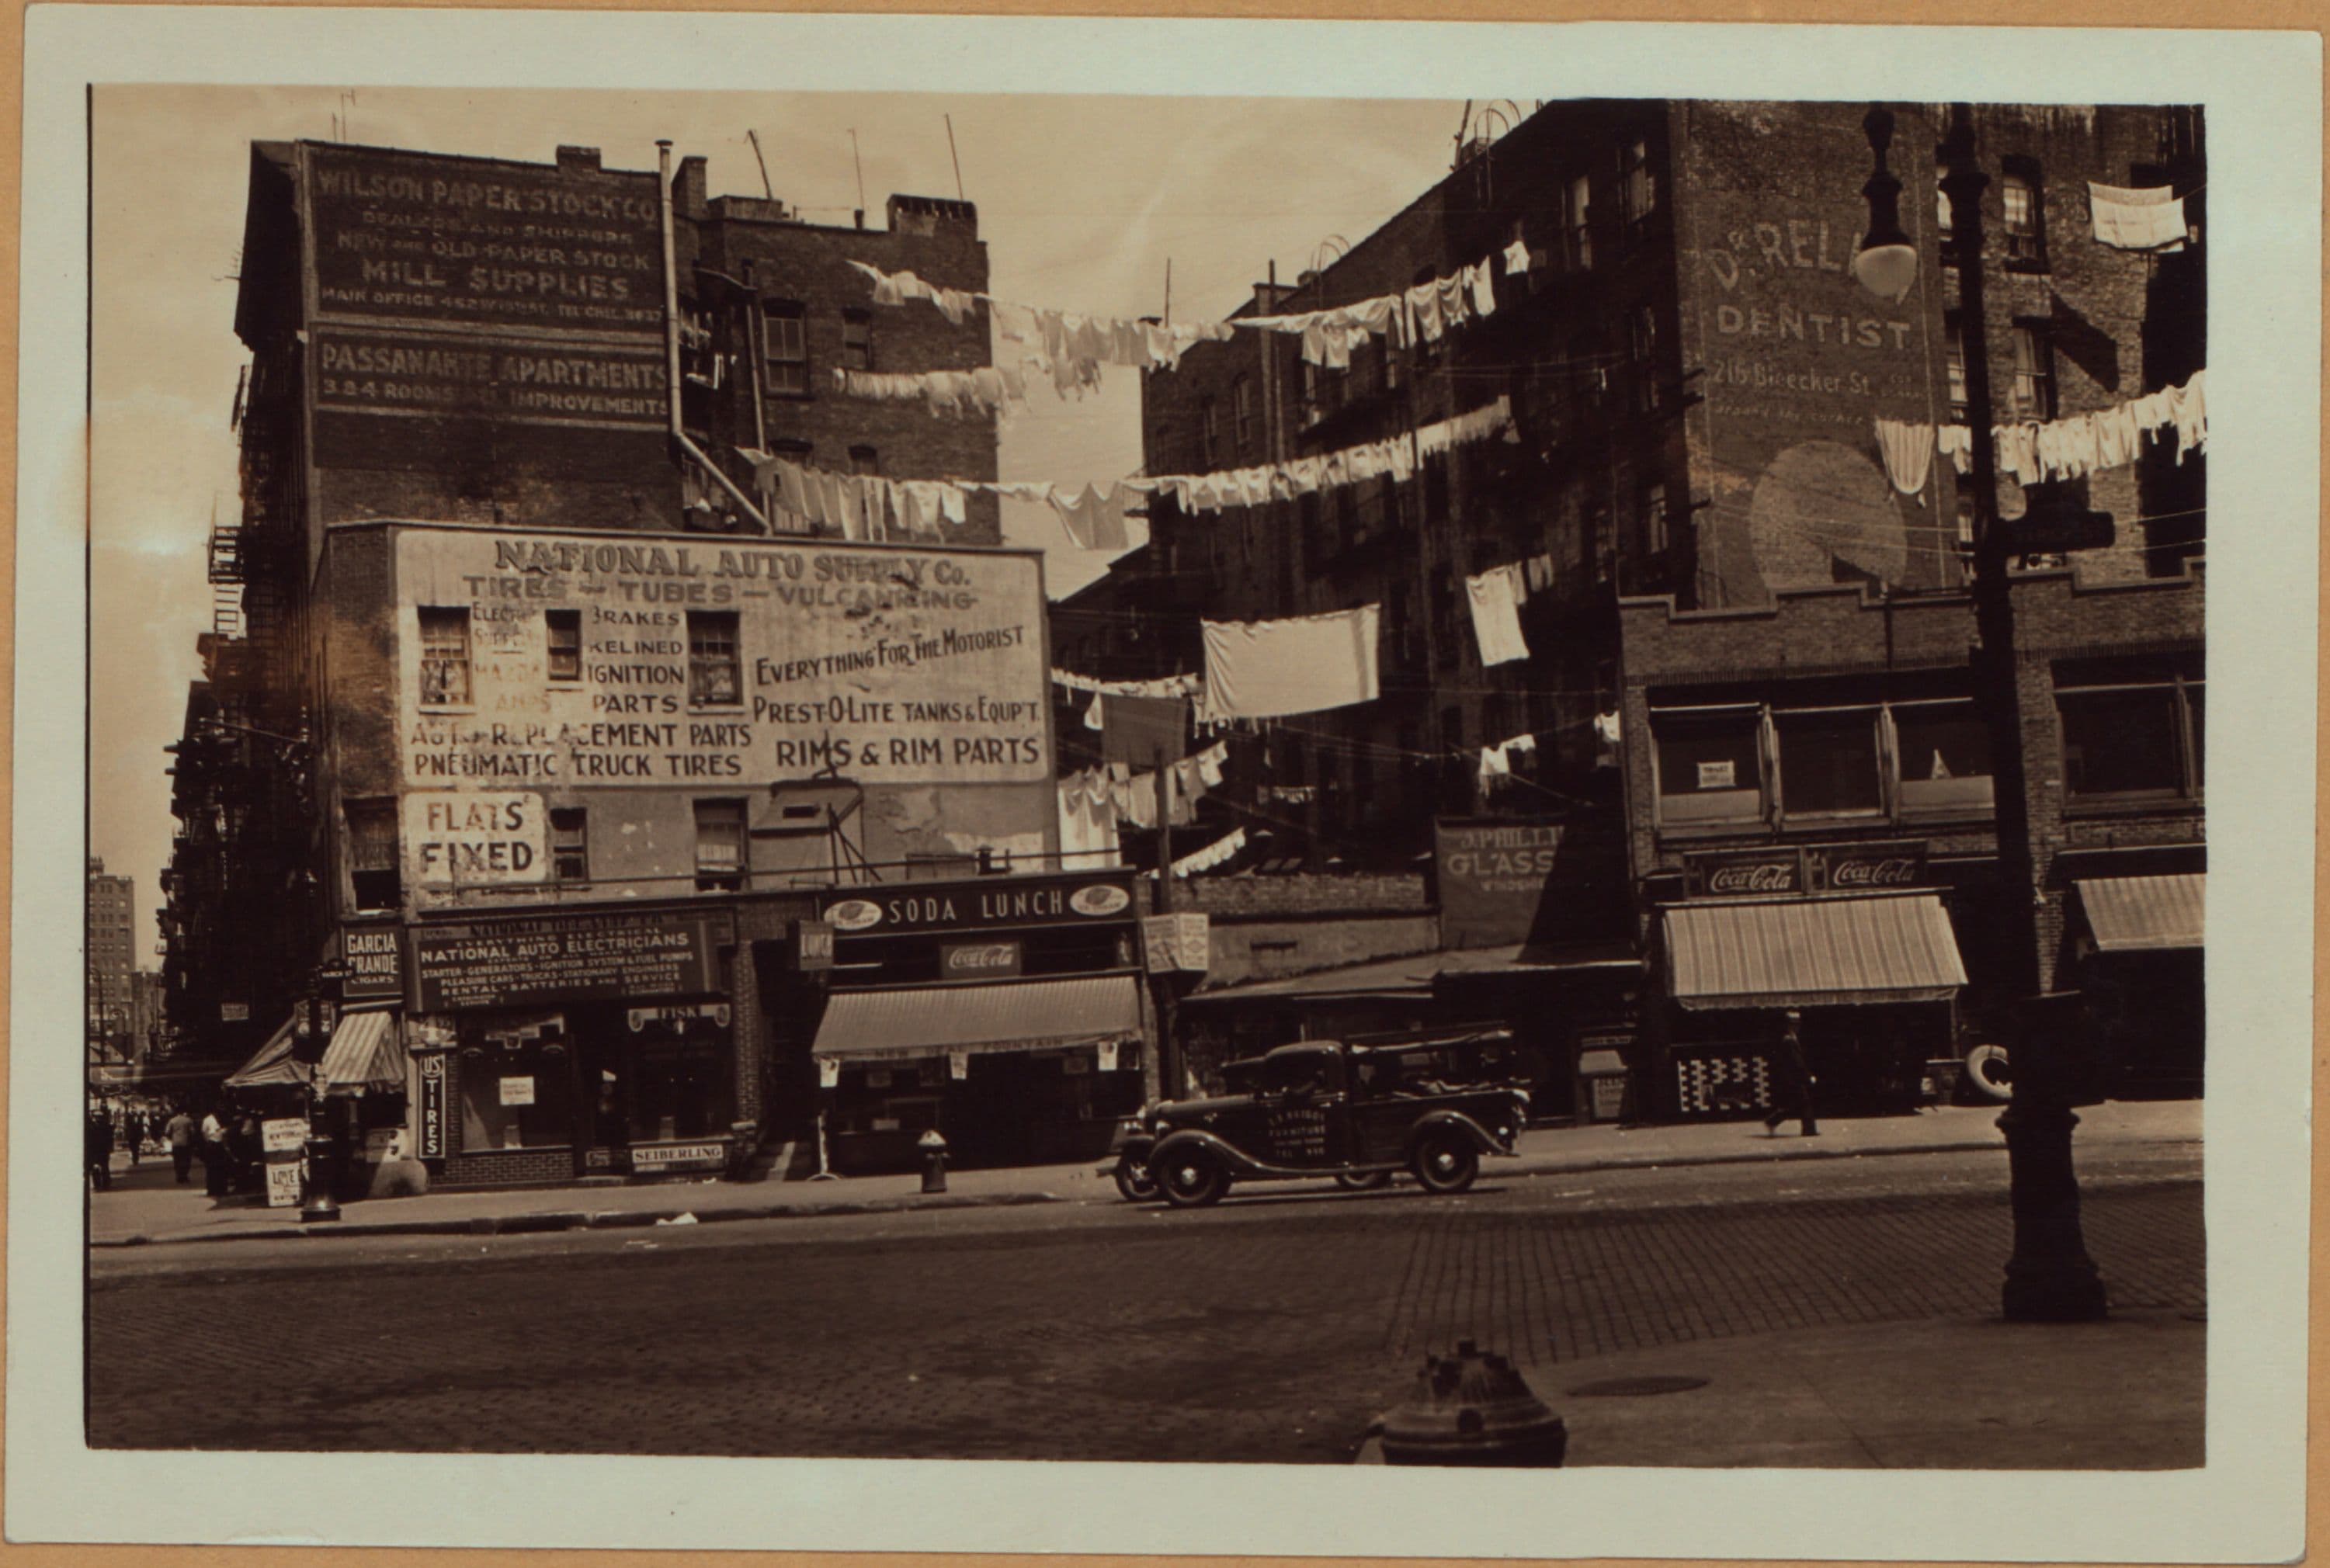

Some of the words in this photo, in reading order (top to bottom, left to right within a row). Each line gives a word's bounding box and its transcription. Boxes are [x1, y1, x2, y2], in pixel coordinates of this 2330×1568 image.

[317, 168, 425, 201] WILSON
[431, 179, 522, 212] PAPER
[528, 188, 621, 220] STOCK
[431, 240, 477, 258] OLD
[486, 244, 567, 266] PAPER
[573, 249, 650, 272] STOCK
[362, 256, 446, 288] MILL
[468, 265, 630, 302] SUPPLIES
[321, 286, 367, 306] MAIN
[372, 291, 436, 308] OFFICE
[1717, 303, 1911, 350] DENTIST
[321, 342, 492, 381] PASSANANTE
[496, 355, 666, 391] APARTMENTS
[509, 389, 667, 416] IMPROVEMENTS
[495, 539, 699, 577] NATIONAL
[713, 550, 804, 580] AUTO
[462, 575, 568, 600] TIRES
[617, 580, 733, 605] TUBES
[942, 625, 1025, 655] MOTORIST
[587, 664, 685, 685] IGNITION
[592, 694, 679, 714] PARTS
[901, 702, 962, 723] TANKS
[964, 705, 977, 722] &
[689, 723, 752, 748] PARTS
[414, 751, 558, 777] PNEUMATIC
[574, 751, 652, 777] TRUCK
[665, 753, 742, 776] TIRES
[776, 738, 852, 768] RIMS
[859, 742, 880, 766] &
[889, 738, 943, 765] RIM
[953, 737, 1040, 765] PARTS
[426, 800, 524, 832] FLATS
[420, 841, 533, 873] FIXED
[1446, 850, 1555, 876] GLASS
[888, 898, 957, 924] SODA
[981, 890, 1063, 919] LUNCH
[346, 931, 398, 955] GARCIA
[420, 945, 510, 963] NATIONAL
[516, 942, 560, 956] AUTO
[566, 931, 690, 953] ELECTRICIANS
[422, 966, 463, 979] STARTER
[467, 962, 533, 975] GENERATORS
[587, 956, 625, 967] SYSTEM
[489, 974, 514, 983] CARS
[441, 985, 499, 997] RENTAL
[509, 977, 591, 992] BATTERIES
[623, 972, 681, 984] SERVICE
[659, 1005, 698, 1020] FISK
[426, 1080, 439, 1154] TIRES
[634, 1147, 722, 1162] SEIBERLING
